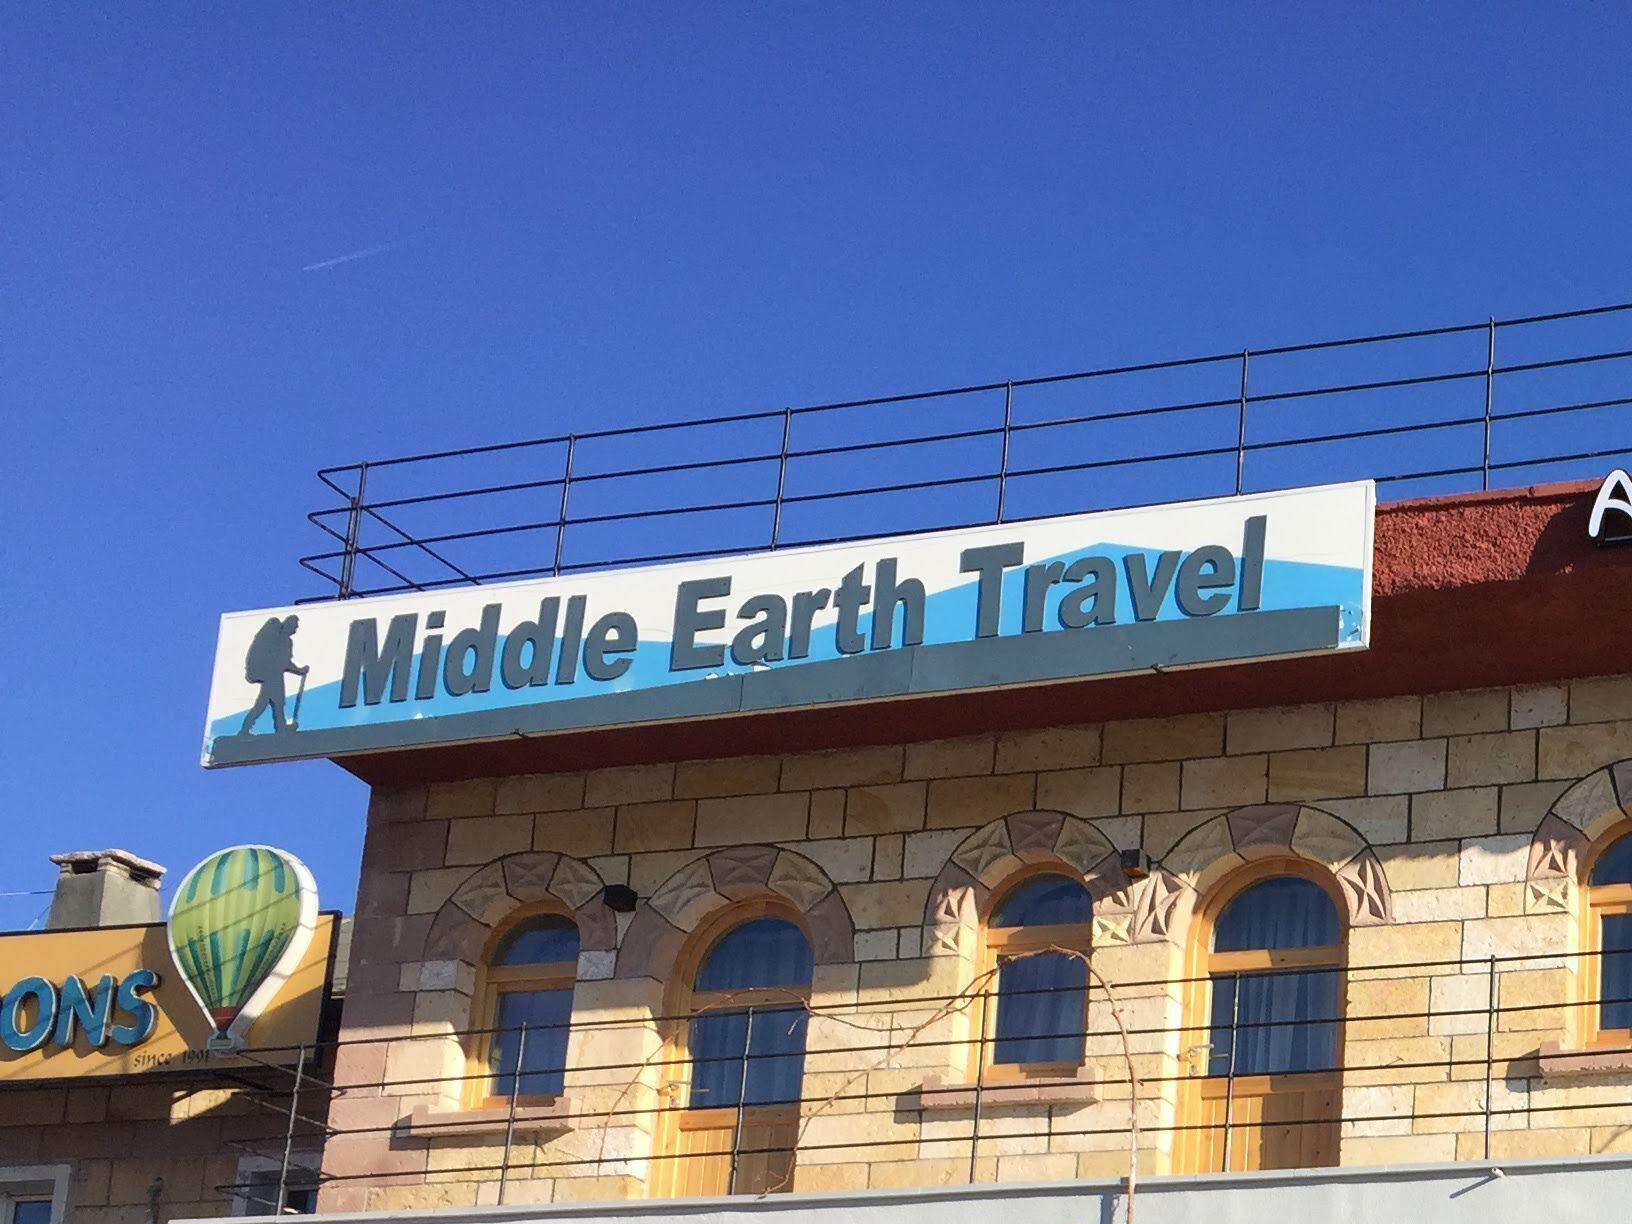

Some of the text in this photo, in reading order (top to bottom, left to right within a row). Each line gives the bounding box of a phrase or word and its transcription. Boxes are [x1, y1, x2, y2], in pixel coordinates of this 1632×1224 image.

[337, 514, 1268, 710] Middle Earth Travel
[133, 1049, 172, 1068] since
